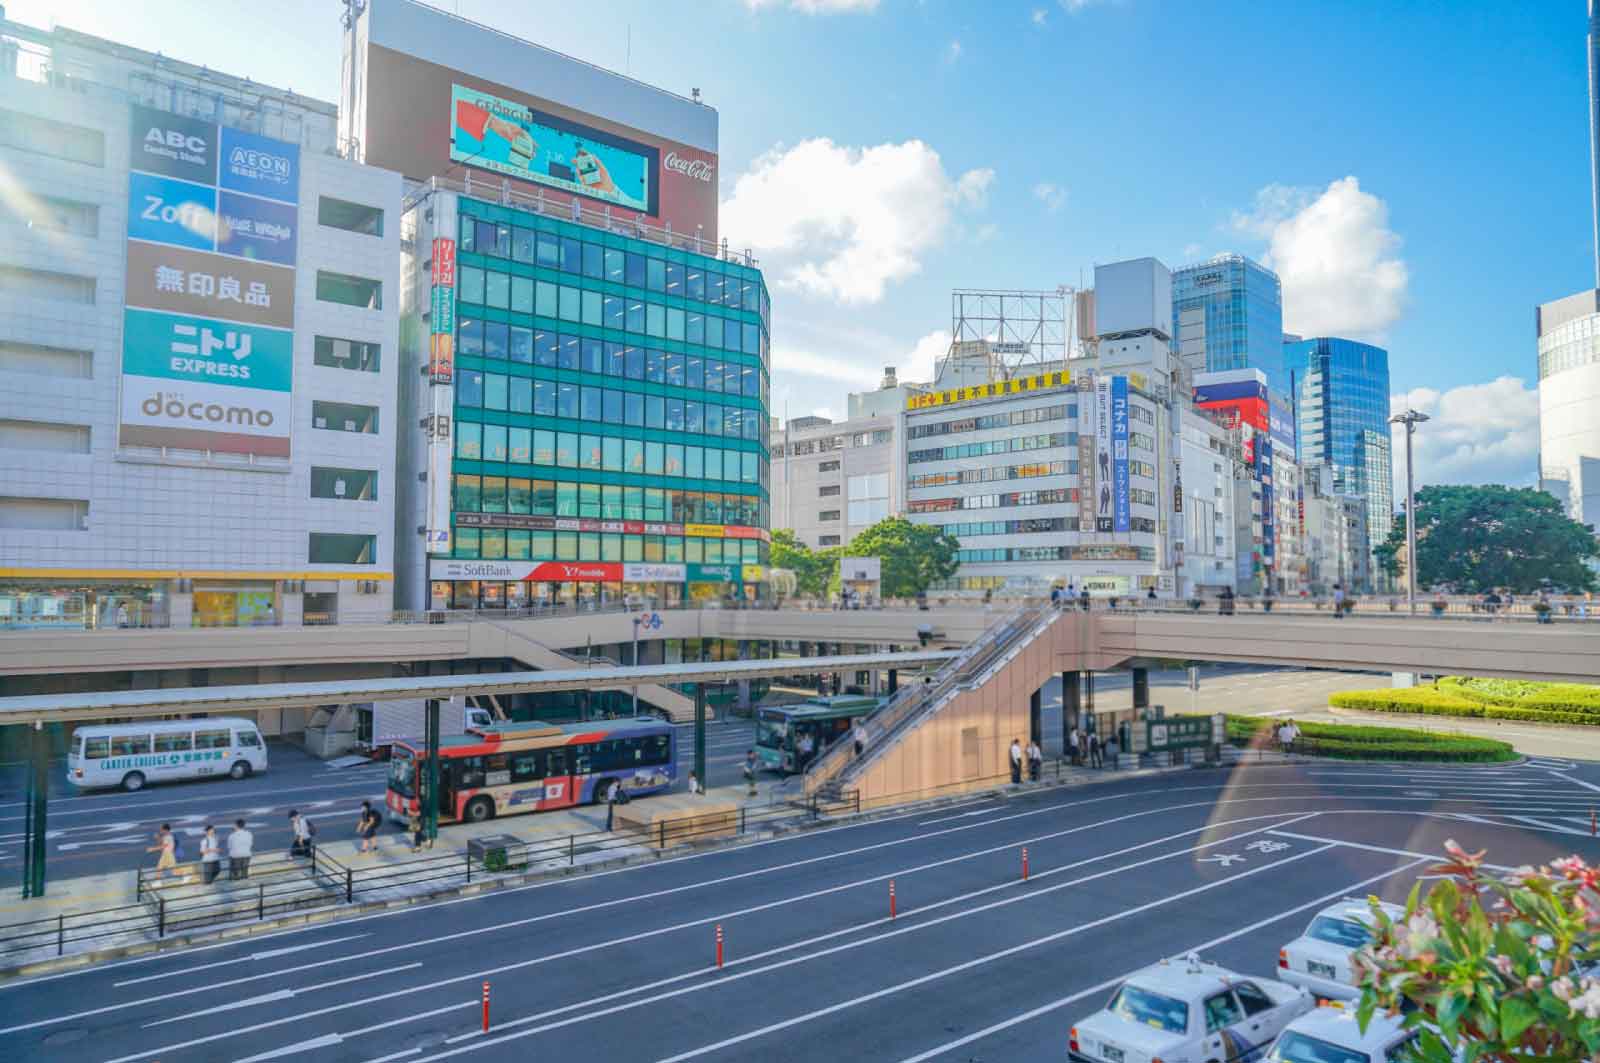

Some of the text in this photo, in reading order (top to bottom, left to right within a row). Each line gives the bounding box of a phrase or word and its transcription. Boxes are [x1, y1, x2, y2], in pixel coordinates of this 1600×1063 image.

[144, 127, 208, 153] ABC
[231, 148, 290, 177] AEON
[155, 266, 271, 308] 無印良品
[170, 323, 253, 361] ニトリ
[170, 357, 251, 379] EXPRESS
[141, 392, 274, 427] docomo
[1114, 399, 1126, 433] コナカ
[463, 563, 512, 577] SoftBank
